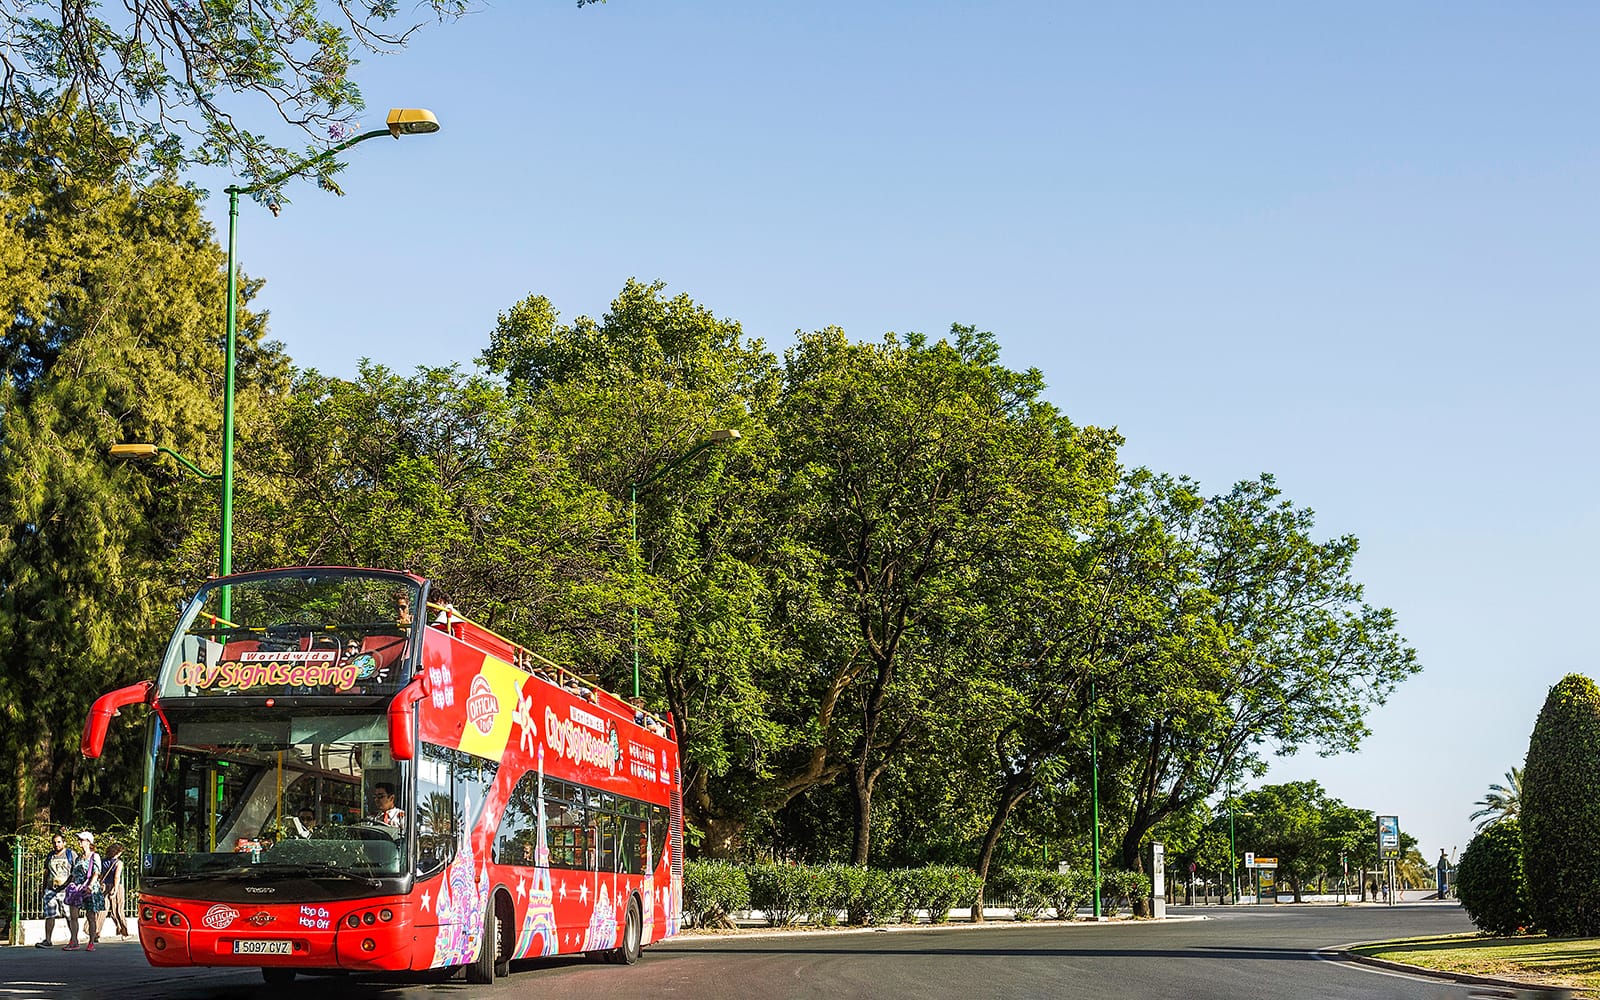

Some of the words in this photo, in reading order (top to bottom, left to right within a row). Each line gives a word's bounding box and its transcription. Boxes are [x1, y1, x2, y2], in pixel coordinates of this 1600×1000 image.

[246, 653, 330, 661] Worldwide
[429, 666, 442, 688] Hop
[441, 663, 452, 685] On
[432, 688, 445, 711] Hop
[444, 685, 455, 707] Off
[470, 696, 498, 719] OFFICIAL
[205, 911, 238, 924] OFFICIAL
[300, 905, 316, 916] Hop
[317, 907, 329, 918] On
[299, 917, 316, 928] Hop
[316, 919, 330, 929] Off
[243, 942, 267, 953] 5097
[269, 942, 288, 953] CVZ
